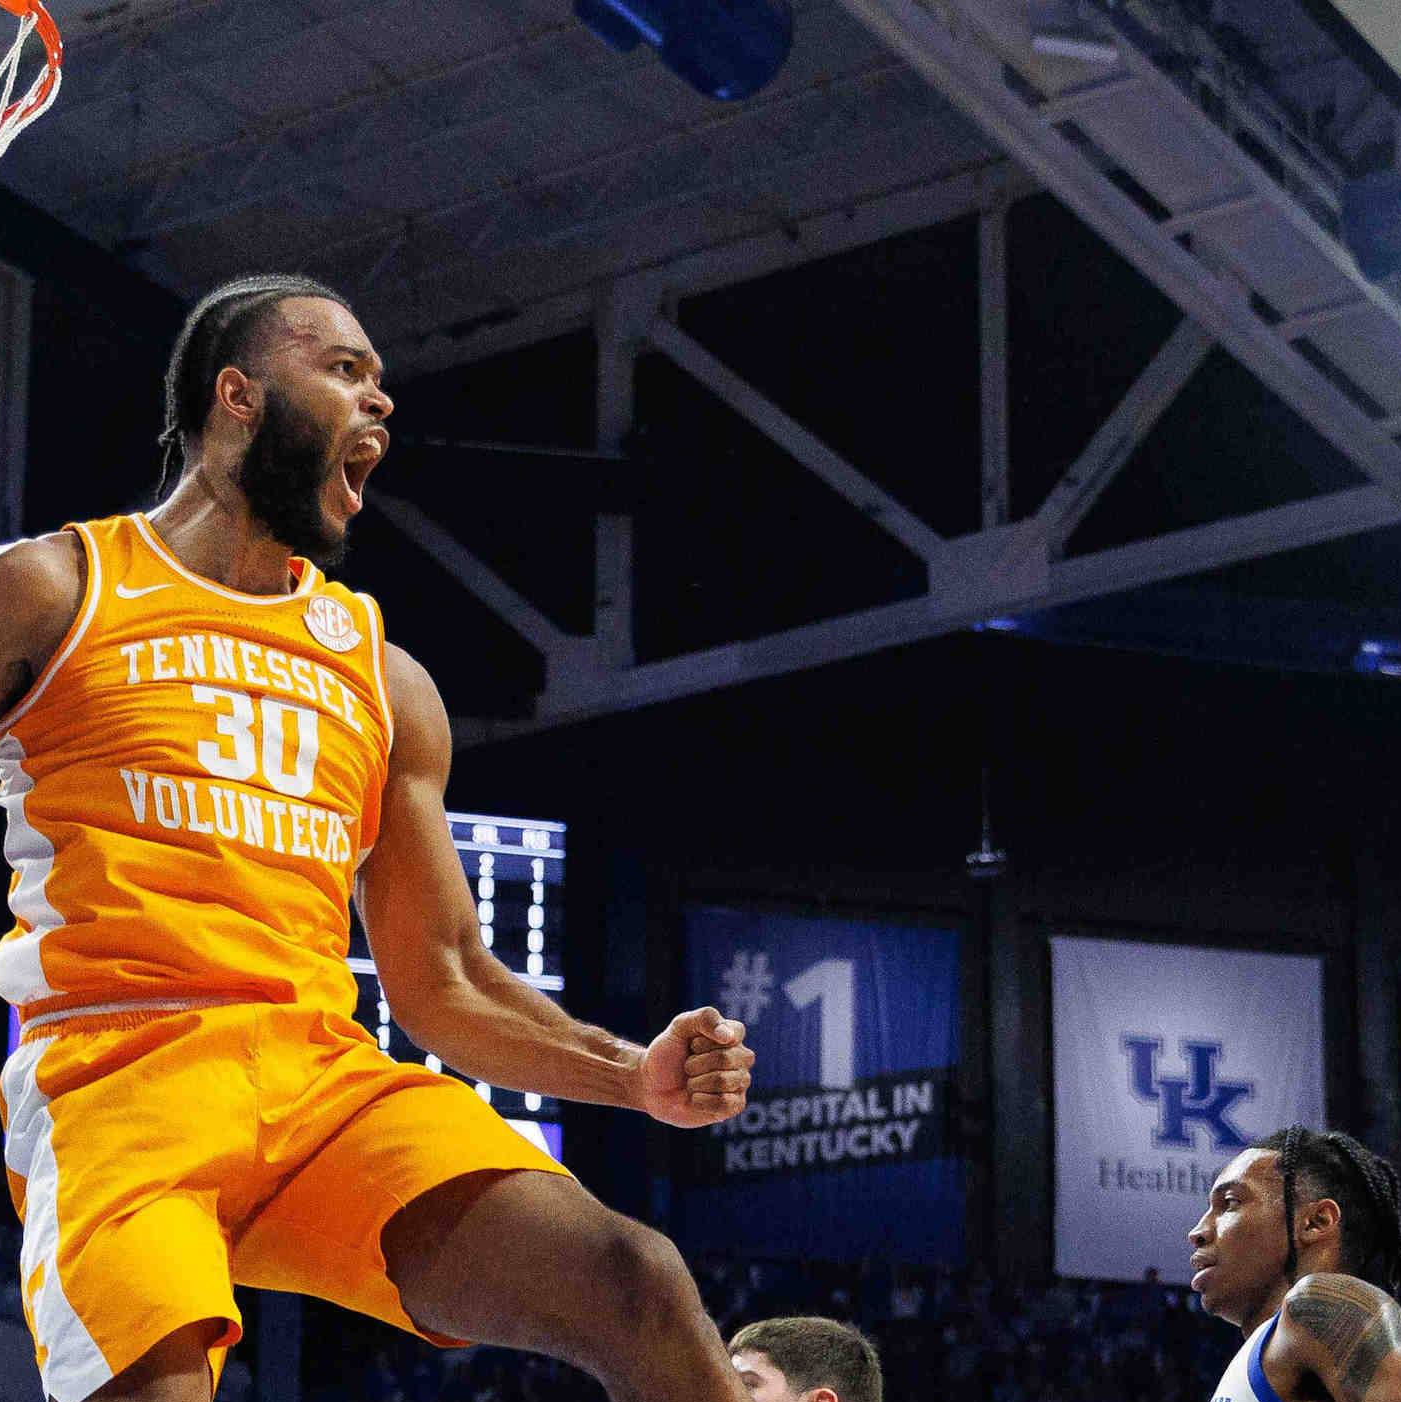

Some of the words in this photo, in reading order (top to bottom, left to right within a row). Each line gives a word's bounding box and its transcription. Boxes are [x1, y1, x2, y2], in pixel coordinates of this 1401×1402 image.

[119, 633, 364, 735] TENNESSEE
[191, 683, 319, 799] 30
[119, 768, 355, 864] VOLUNTEERS
[719, 949, 856, 1090] #1
[892, 1081, 934, 1114] IN
[1121, 1033, 1255, 1151] UK
[724, 1119, 921, 1171] KENTUCKY
[1097, 1157, 1212, 1196] Health
